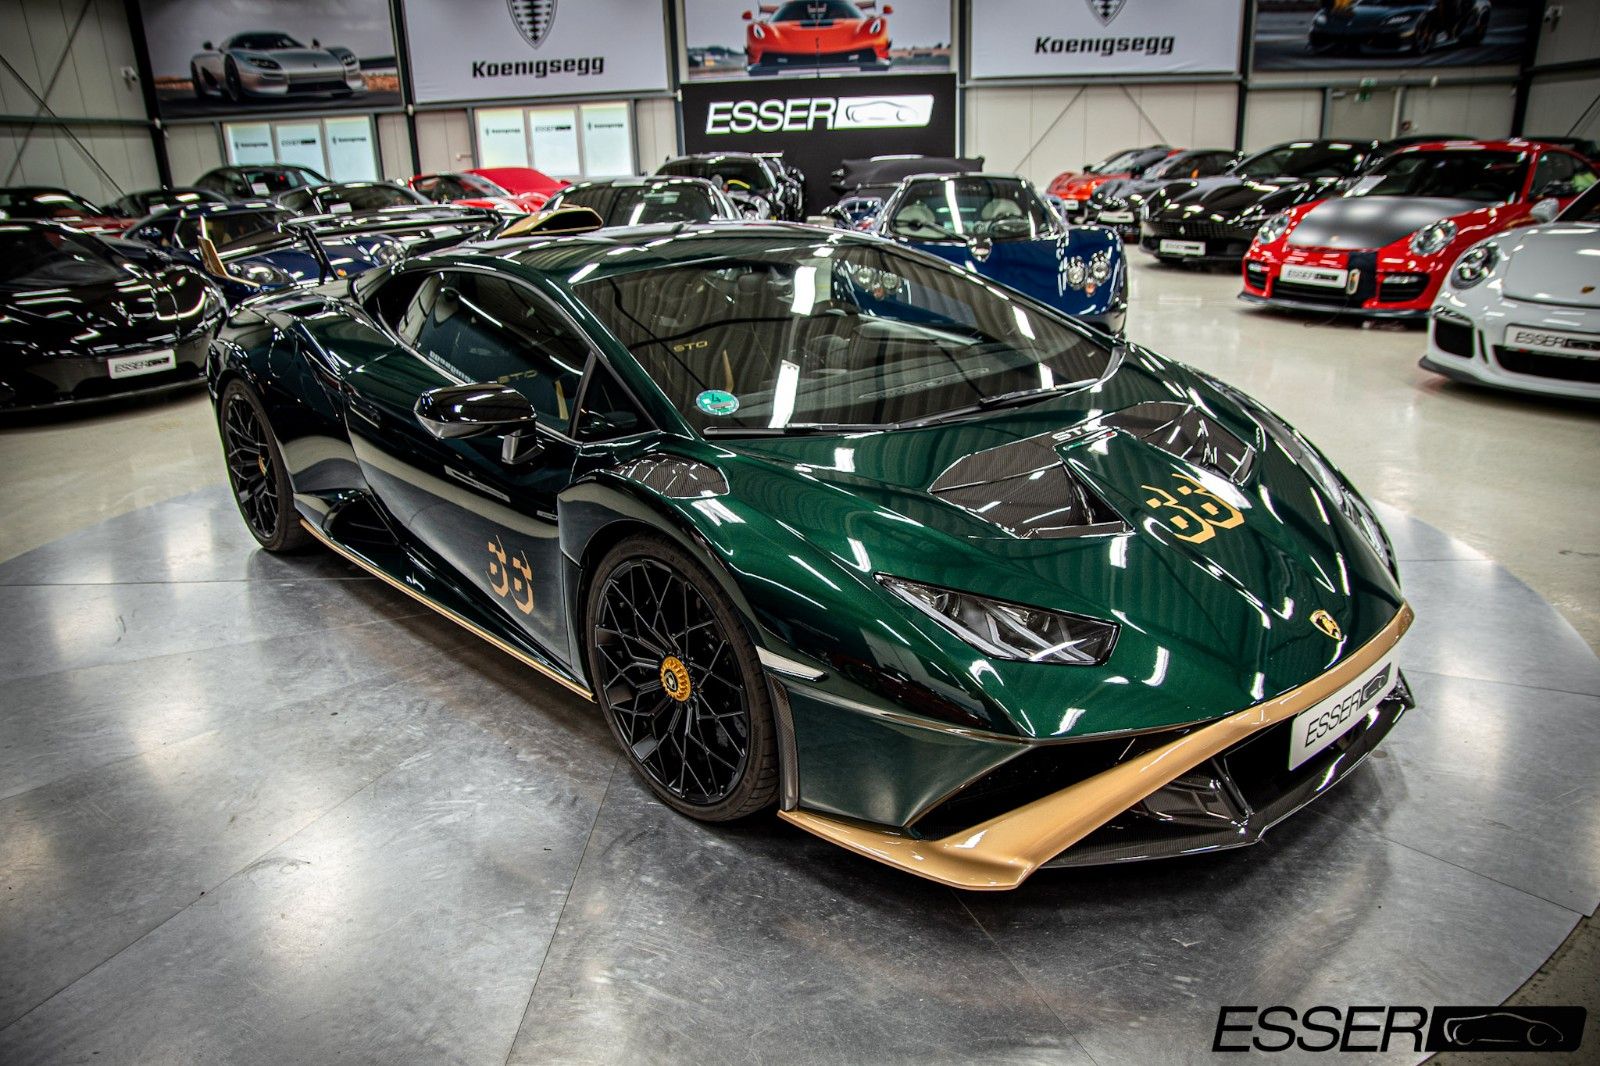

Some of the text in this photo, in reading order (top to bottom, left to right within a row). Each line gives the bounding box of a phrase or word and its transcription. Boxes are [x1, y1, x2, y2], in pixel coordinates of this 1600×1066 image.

[1034, 36, 1175, 56] Koenigsegg
[472, 57, 605, 79] Koenigsegg
[705, 96, 838, 135] ESSER
[1514, 331, 1568, 348] ESSER
[1304, 688, 1362, 748] ESSER
